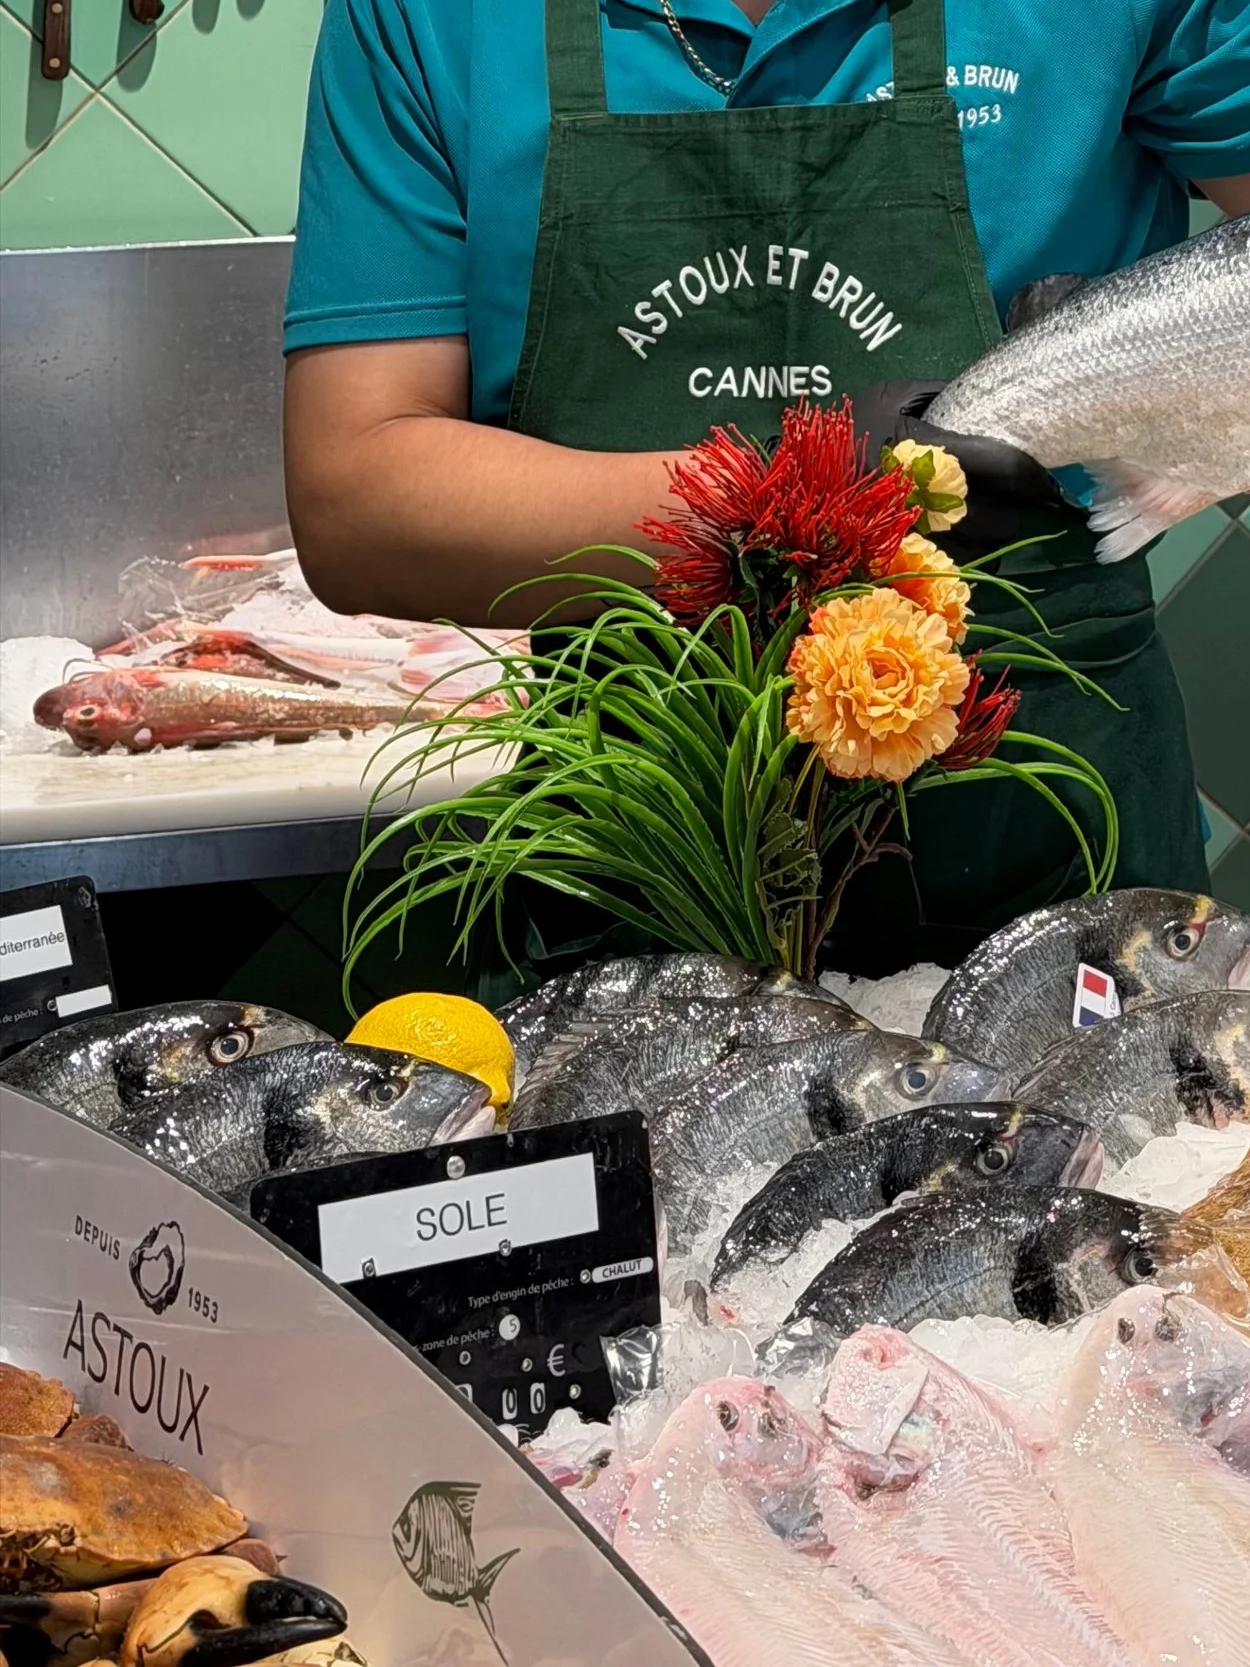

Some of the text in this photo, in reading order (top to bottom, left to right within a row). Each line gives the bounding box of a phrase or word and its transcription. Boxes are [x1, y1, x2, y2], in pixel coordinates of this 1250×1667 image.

[946, 65, 1020, 94] & BRUN
[957, 104, 1001, 130] 1953
[616, 244, 902, 359] ASTOUX ET BRUN
[688, 365, 832, 398] CANNES
[416, 1193, 507, 1241] SOLE
[75, 1215, 218, 1323] DEPUIS 1953
[468, 1295, 491, 1310] Type
[492, 1287, 527, 1303] d'engin
[528, 1283, 540, 1294] de
[602, 1259, 642, 1278] CHALUT
[446, 1334, 459, 1346] de
[509, 1318, 517, 1333] 5
[63, 1299, 210, 1456] ASTOUX
[547, 1343, 566, 1377] €
